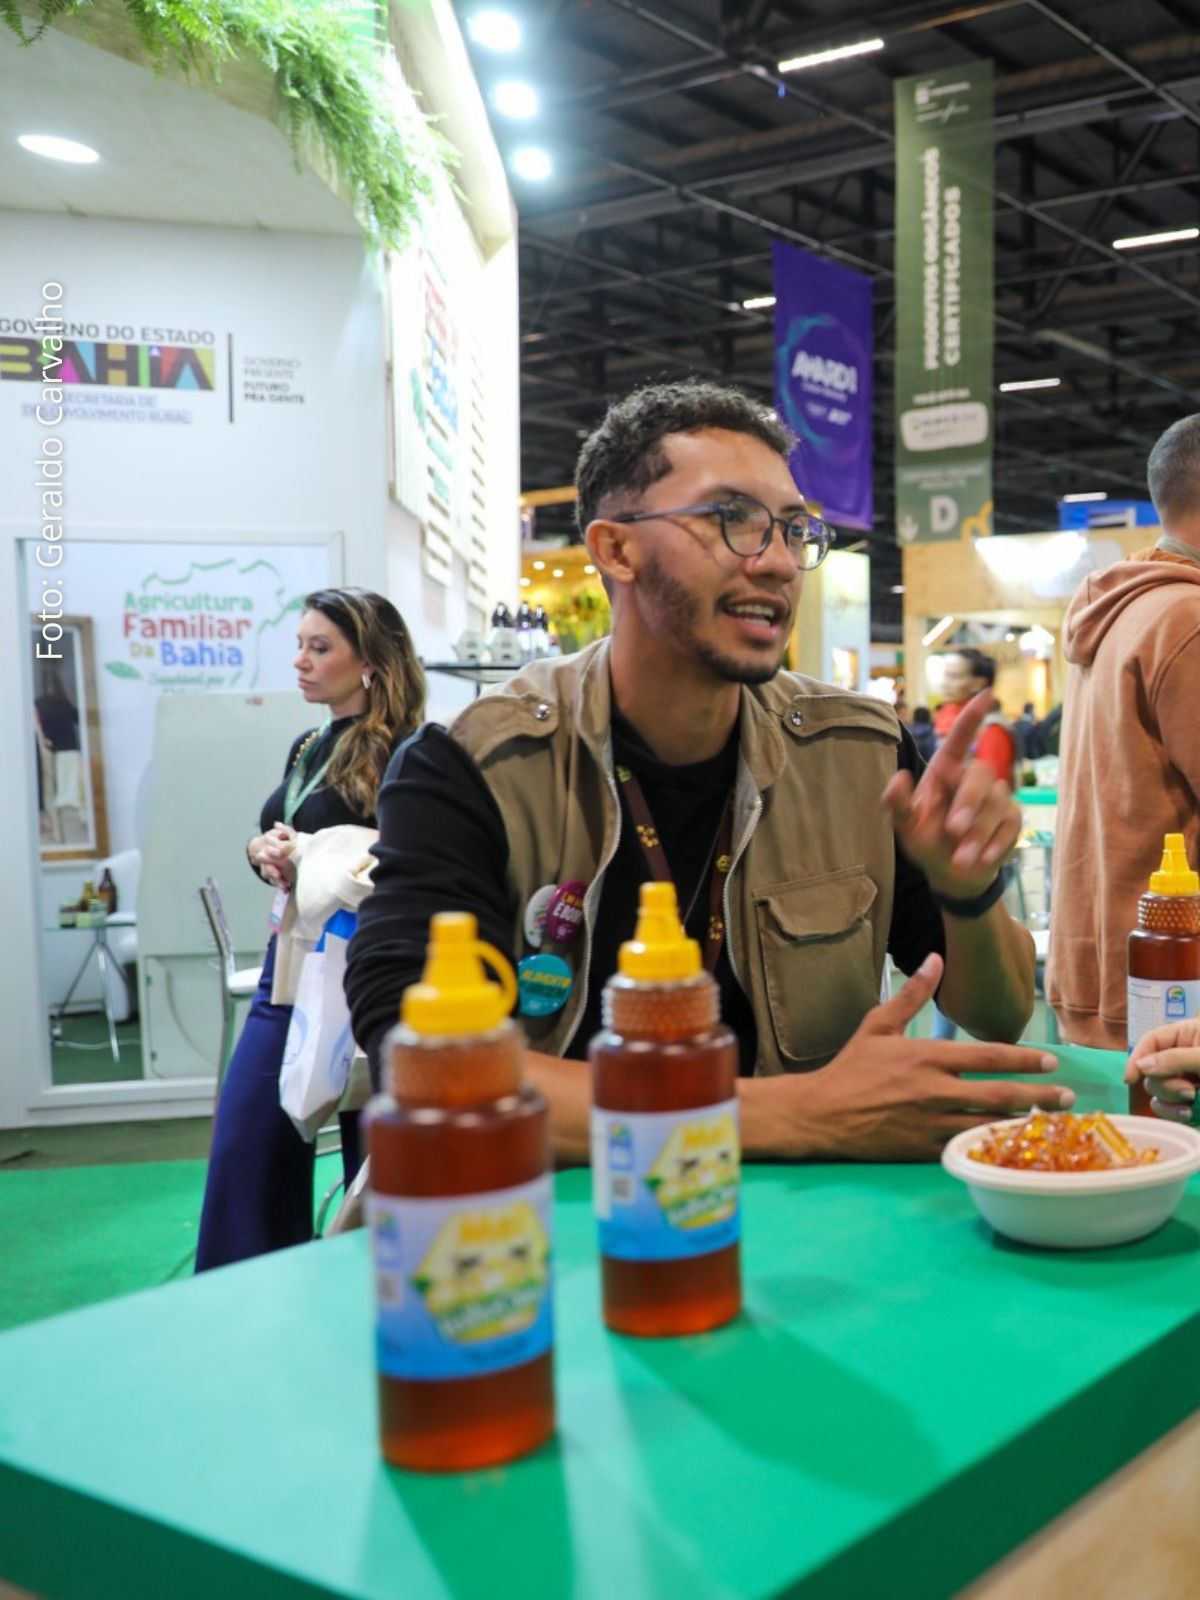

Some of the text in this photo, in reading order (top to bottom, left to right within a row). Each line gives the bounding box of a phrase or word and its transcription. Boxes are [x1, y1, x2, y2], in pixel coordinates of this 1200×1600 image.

[943, 186, 961, 366] CERTIFICADOS
[0, 318, 215, 345] GOVERNO DO ESTADO
[929, 495, 959, 533] D
[124, 591, 253, 613] Agricultura
[122, 613, 252, 639] Familiar
[161, 640, 243, 667] Bahia
